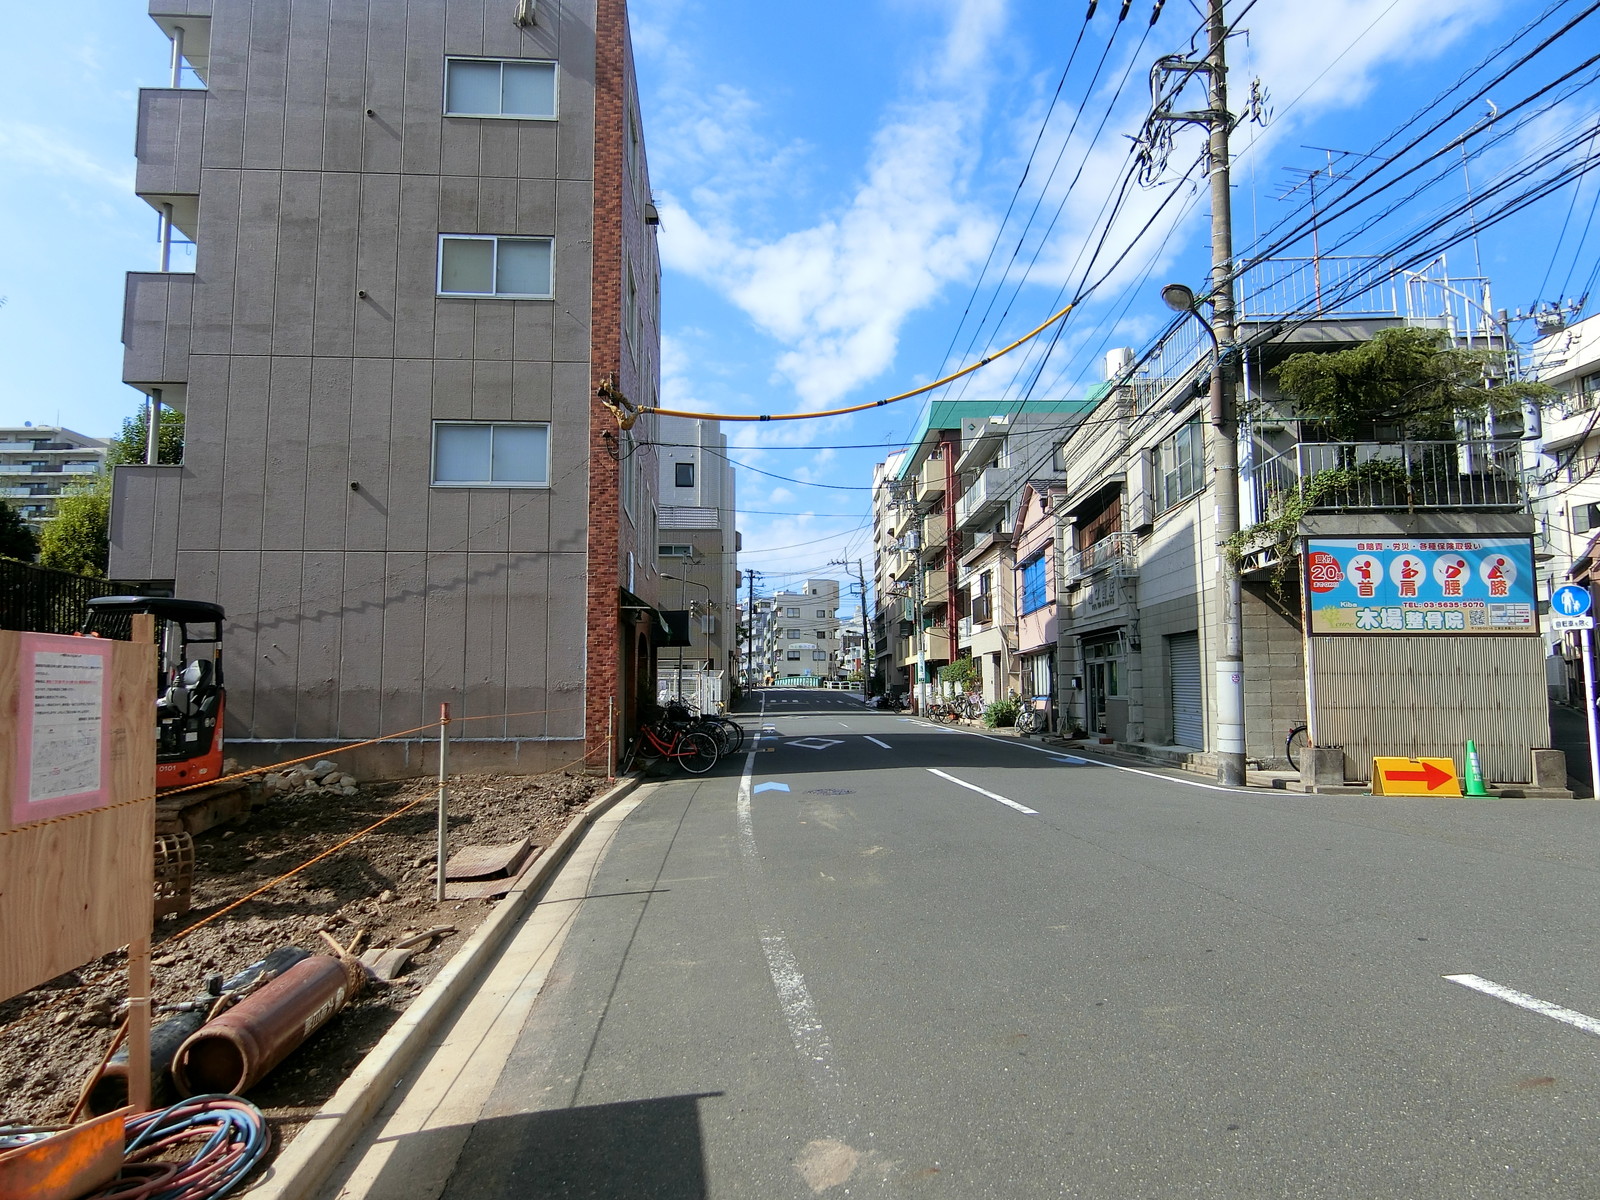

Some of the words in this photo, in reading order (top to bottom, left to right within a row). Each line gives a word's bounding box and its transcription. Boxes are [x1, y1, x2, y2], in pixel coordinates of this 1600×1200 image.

[1357, 580, 1374, 596] 首
[1400, 580, 1416, 597] 肩
[1444, 580, 1462, 596] 腰
[1490, 580, 1508, 596] 膝
[1356, 607, 1465, 630] 木場整骨院
